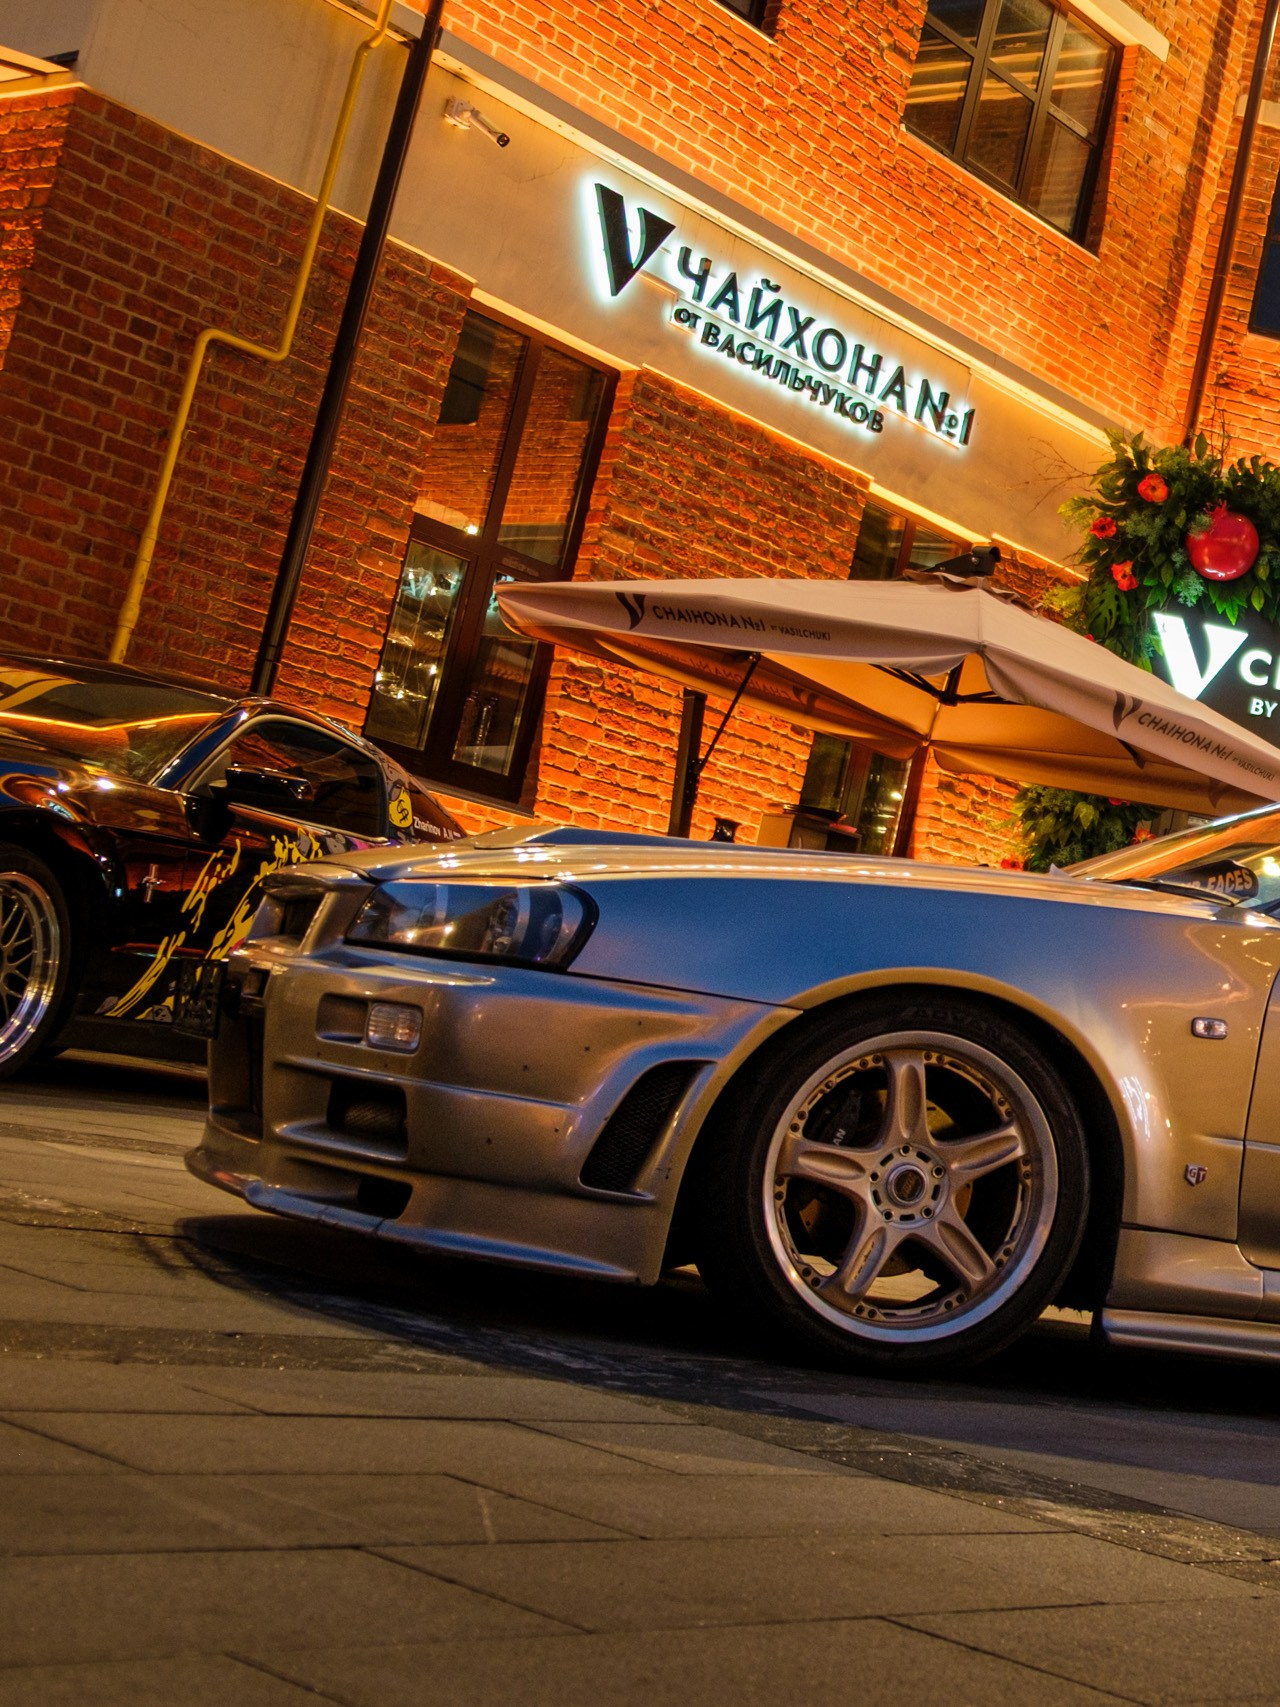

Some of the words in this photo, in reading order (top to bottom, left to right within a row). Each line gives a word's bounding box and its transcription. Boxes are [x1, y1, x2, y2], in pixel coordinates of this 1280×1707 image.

[677, 246, 907, 413] ЧАЙХОНА
[700, 321, 884, 434] ВАСИЛЬЧУКОВ
[652, 605, 741, 630] CHAIHONA
[777, 625, 831, 641] VASILCHUKI
[1250, 698, 1278, 719] BY
[1138, 713, 1212, 753] CHAIHONA
[1237, 758, 1275, 782] VASILCHUKI
[1207, 868, 1253, 893] FACES
[1188, 1166, 1207, 1182] GT
